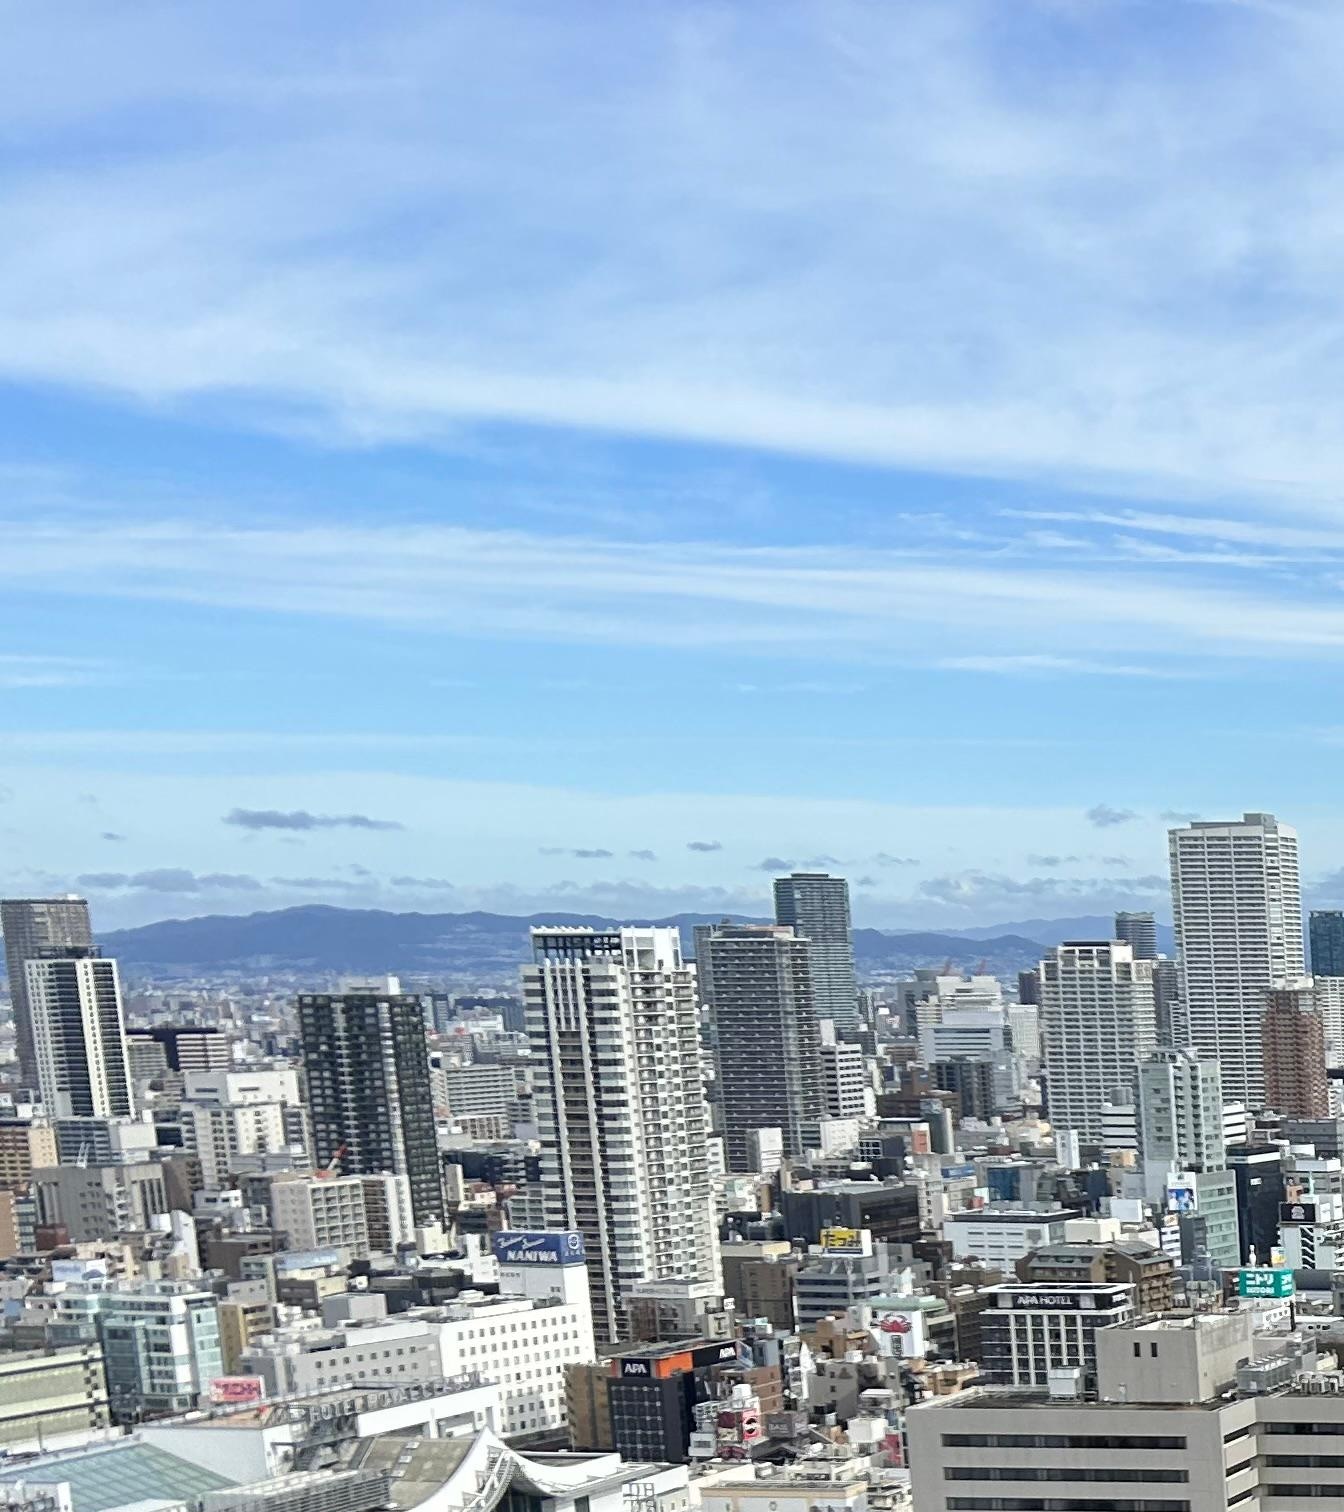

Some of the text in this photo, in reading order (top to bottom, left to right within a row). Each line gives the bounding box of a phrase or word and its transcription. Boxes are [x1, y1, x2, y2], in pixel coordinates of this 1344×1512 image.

[506, 1250, 559, 1262] NANIWA
[1245, 1273, 1275, 1285] ニトリ
[1040, 1295, 1073, 1305] HOTEL
[718, 1346, 736, 1359] APA
[624, 1363, 647, 1374] APA
